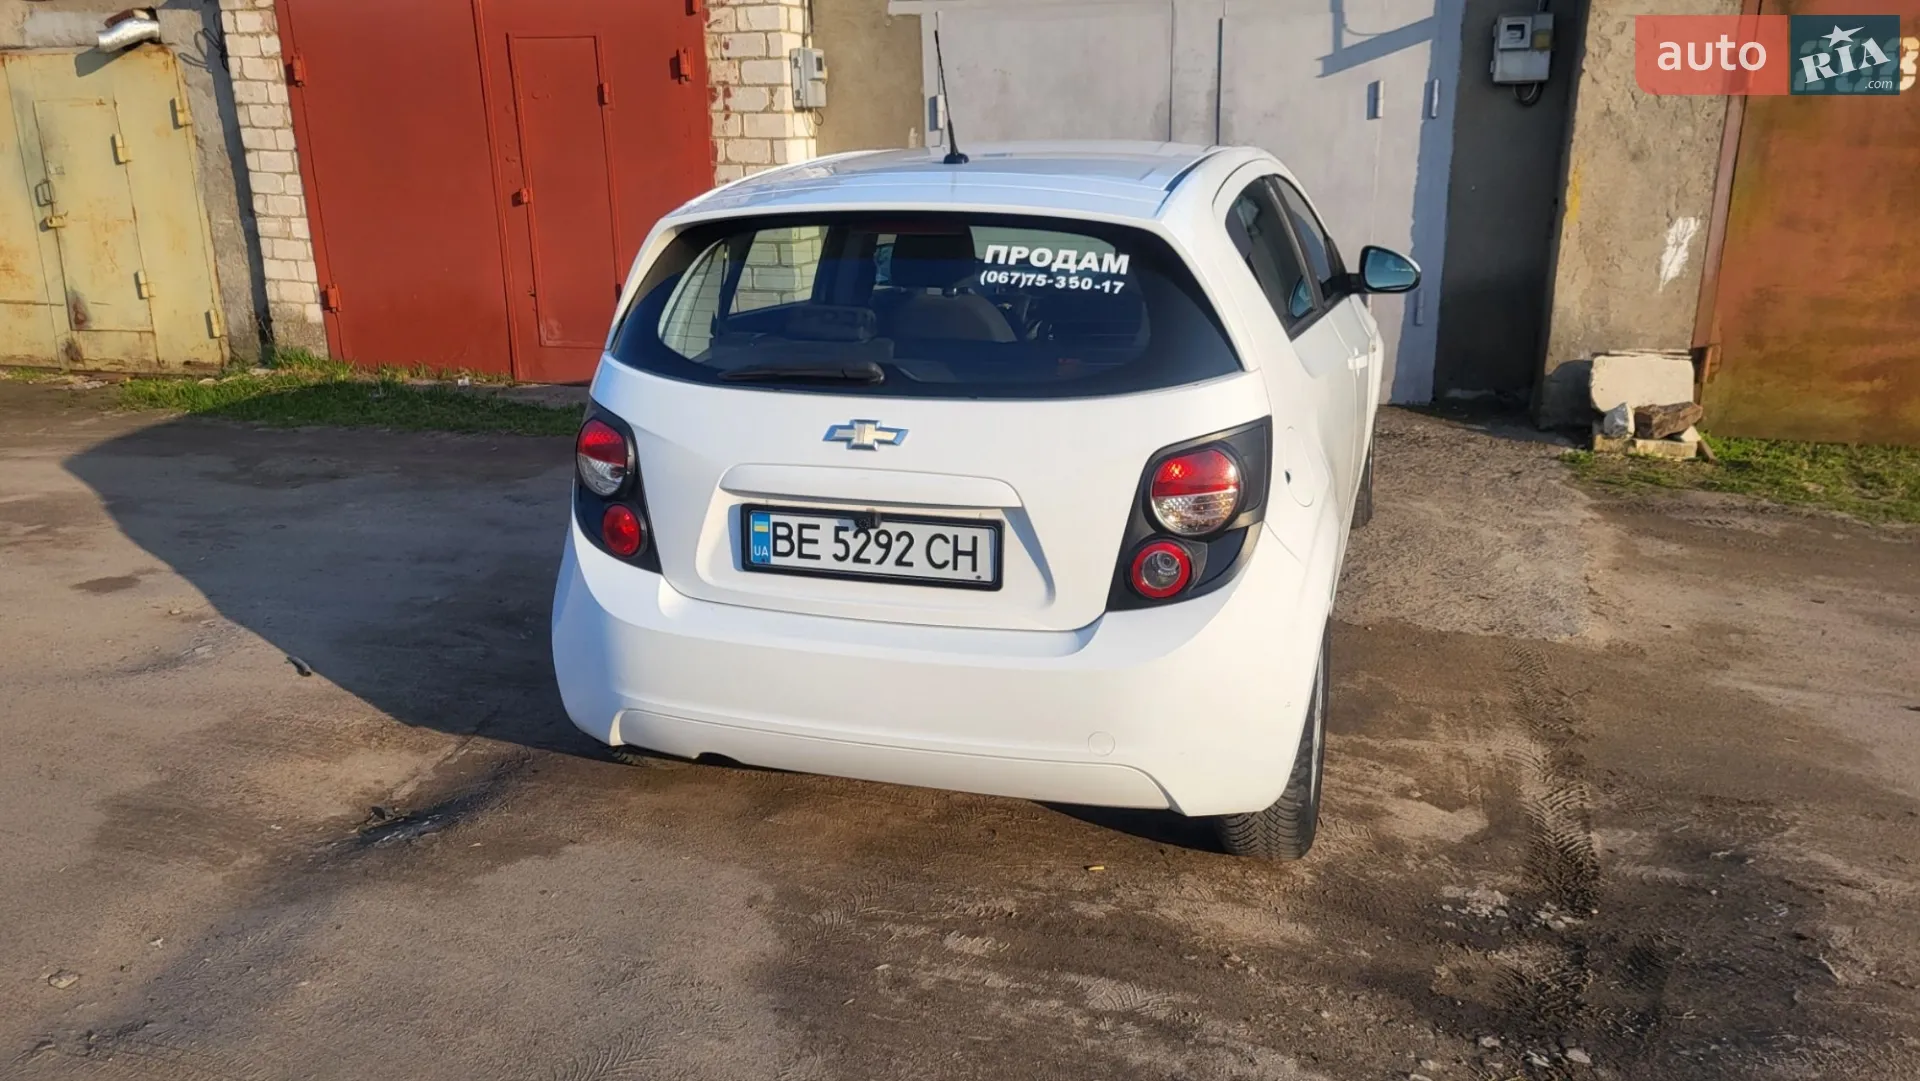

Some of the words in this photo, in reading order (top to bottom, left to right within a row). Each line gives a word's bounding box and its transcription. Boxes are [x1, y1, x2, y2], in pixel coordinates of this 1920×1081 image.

[984, 244, 1130, 275] ПРОДАМ
[979, 270, 1125, 295] (067)75-350-17
[754, 546, 769, 558] UA
[772, 521, 821, 561] BE
[832, 525, 915, 568] 5292
[925, 533, 978, 573] CH
